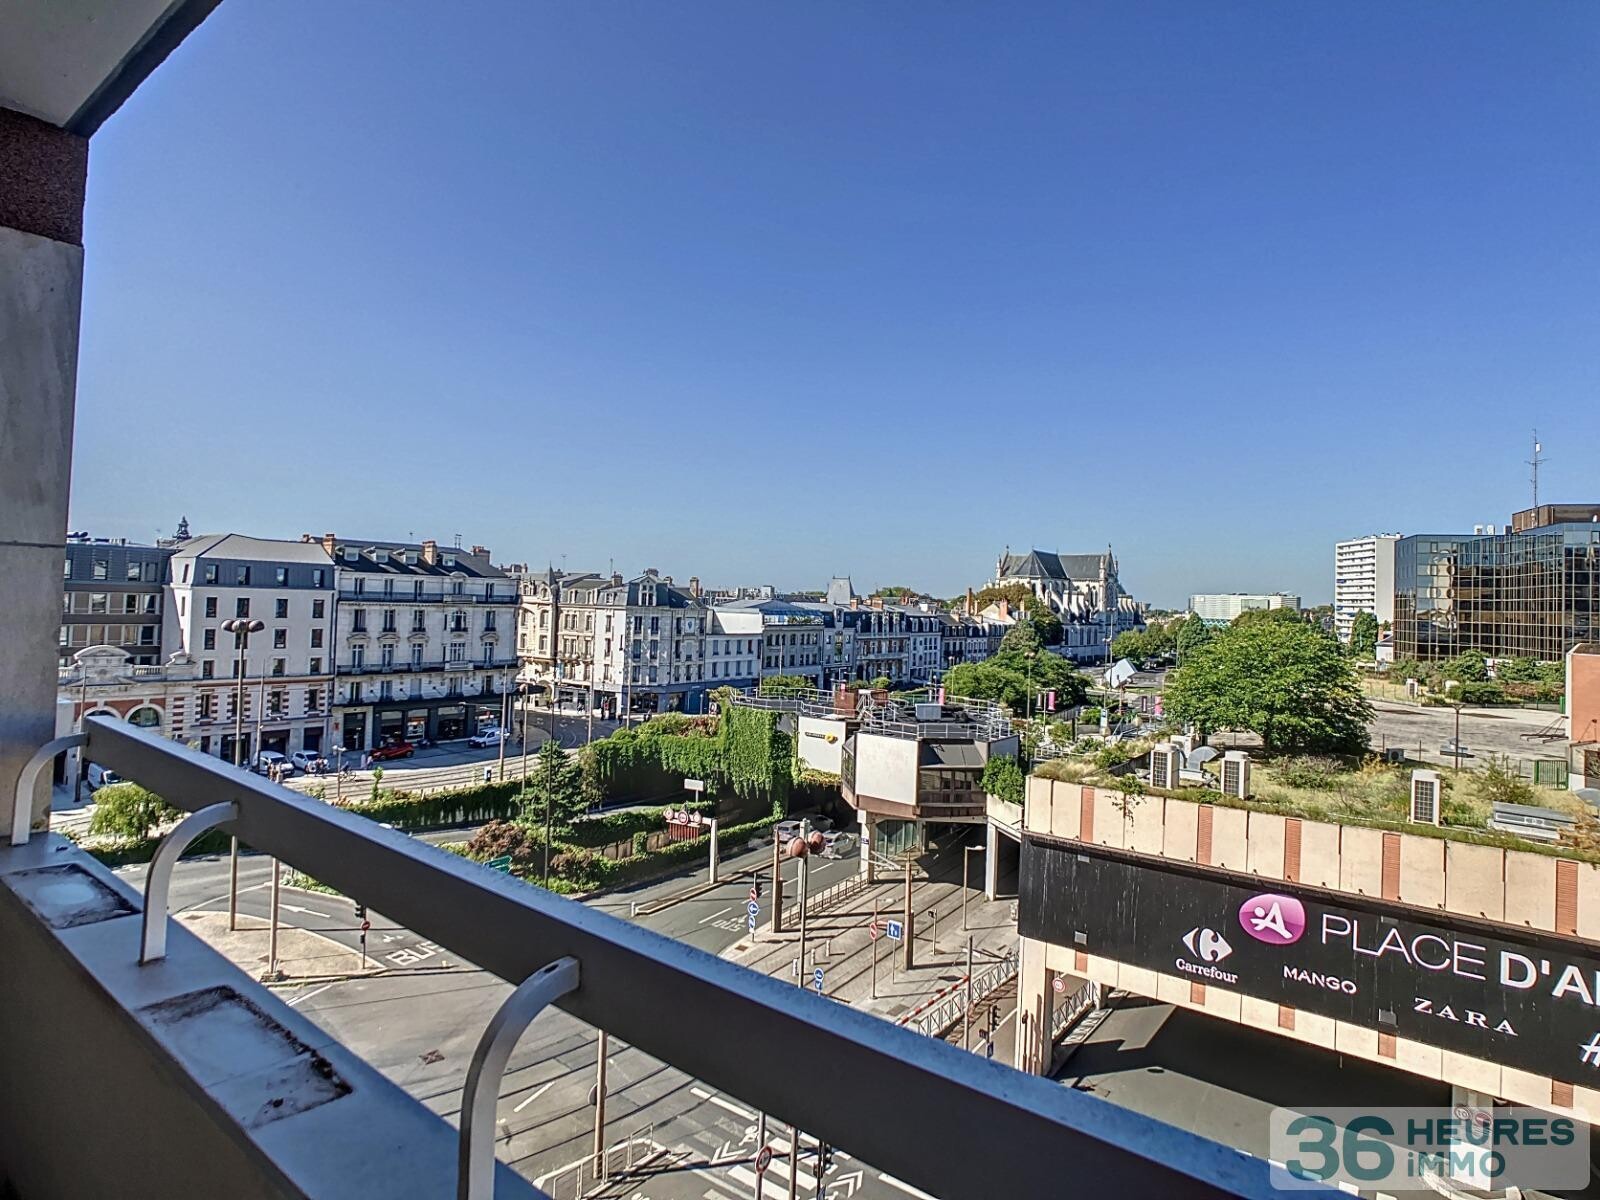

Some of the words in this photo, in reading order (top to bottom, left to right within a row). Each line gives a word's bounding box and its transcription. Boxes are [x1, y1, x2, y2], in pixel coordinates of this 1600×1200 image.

[1321, 913, 1487, 981] PLACE
[1175, 958, 1238, 984] Carrefour
[1284, 965, 1357, 994] MANGO
[1413, 997, 1519, 1037] ZARA
